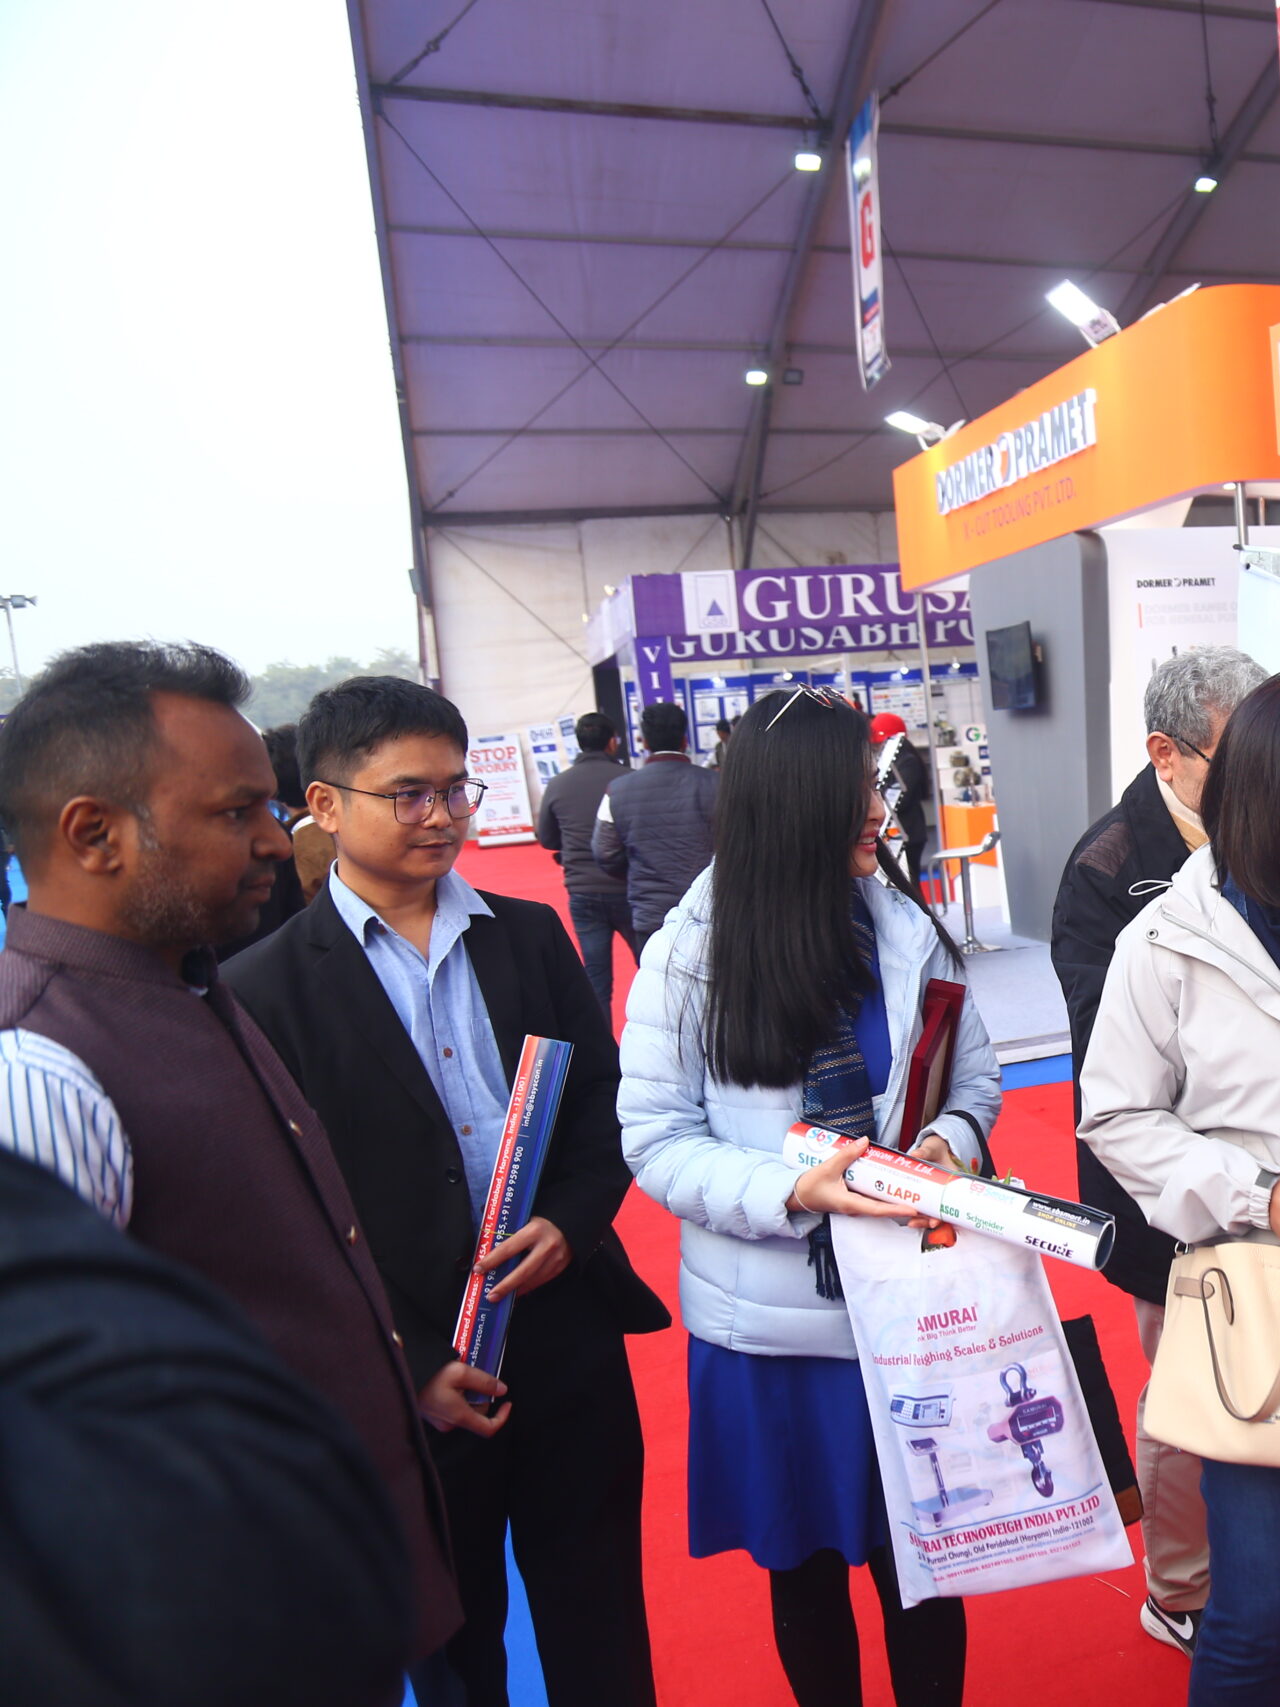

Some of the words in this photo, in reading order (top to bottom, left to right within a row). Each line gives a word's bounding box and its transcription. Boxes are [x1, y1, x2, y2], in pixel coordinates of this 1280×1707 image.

[935, 443, 999, 516] DORMER
[1014, 387, 1098, 478] PRAMET
[991, 492, 1031, 531] TOOLING
[1136, 579, 1173, 588] DORMER
[1182, 578, 1216, 587] PRAMET
[470, 745, 517, 763] STOP
[472, 761, 518, 774] WORRY
[522, 1058, 544, 1127] info@sbsyscon.in
[487, 1171, 504, 1220] Faridabad,
[499, 1135, 513, 1170] Haryana,
[508, 1112, 518, 1134] India
[514, 1146, 523, 1162] 900
[509, 1163, 520, 1185] 9598
[914, 1162, 934, 1177] Ltd.
[505, 1186, 515, 1202] 989
[887, 1184, 921, 1204] LAPP
[940, 1203, 960, 1218] ASCO
[966, 1212, 1004, 1232] Schneider
[1031, 1201, 1091, 1227] www.sbsmart.in
[1037, 1211, 1054, 1222] SHOP
[1055, 1217, 1077, 1229] ONLINE
[1025, 1235, 1074, 1259] SECURE
[927, 1331, 938, 1343] Big
[939, 1328, 956, 1339] Think
[958, 1324, 977, 1334] Better
[953, 1342, 987, 1357] Scales
[988, 1338, 997, 1351] &
[999, 1324, 1044, 1347] Solutions
[942, 1520, 1023, 1551] TECHNOWEIGH
[1025, 1511, 1055, 1530] INDIA
[1056, 1504, 1081, 1523] PVT.
[1081, 1495, 1100, 1514] LTD
[927, 1553, 948, 1565] Purani
[949, 1549, 973, 1563] Chungi,
[973, 1544, 985, 1554] Old
[986, 1536, 1019, 1551] Faridabad
[1020, 1530, 1052, 1545] (Haryana)
[1052, 1515, 1094, 1537] India-121002
